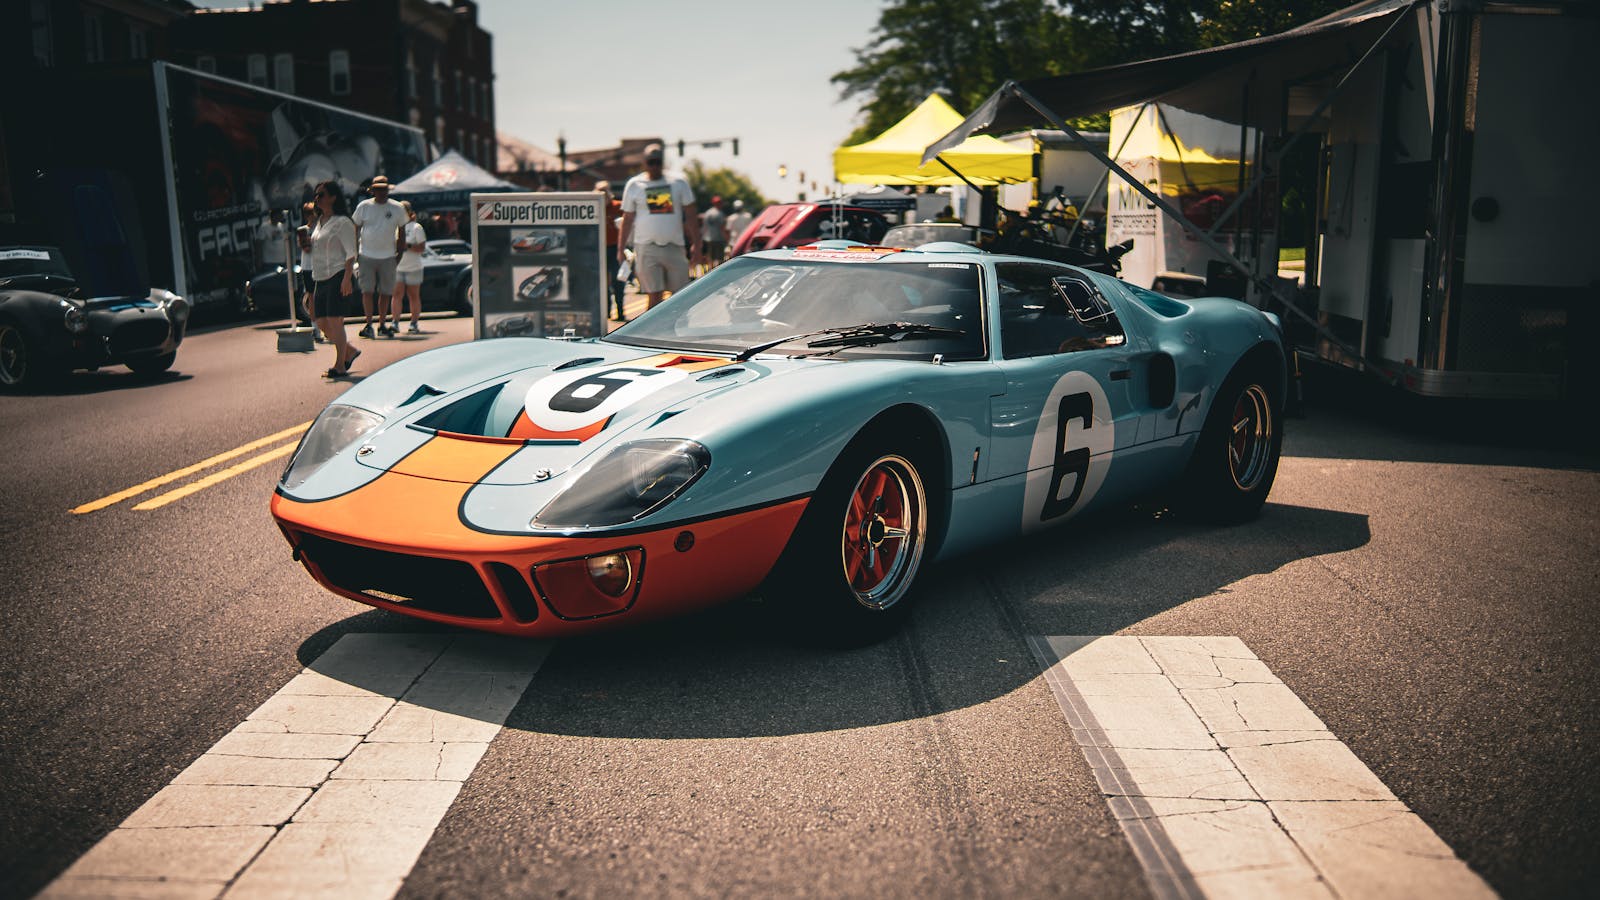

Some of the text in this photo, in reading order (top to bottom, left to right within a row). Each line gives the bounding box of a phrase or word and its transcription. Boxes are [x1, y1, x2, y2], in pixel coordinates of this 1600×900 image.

[494, 202, 595, 223] Superformance
[548, 367, 666, 413] 6
[1040, 391, 1093, 522] 6
